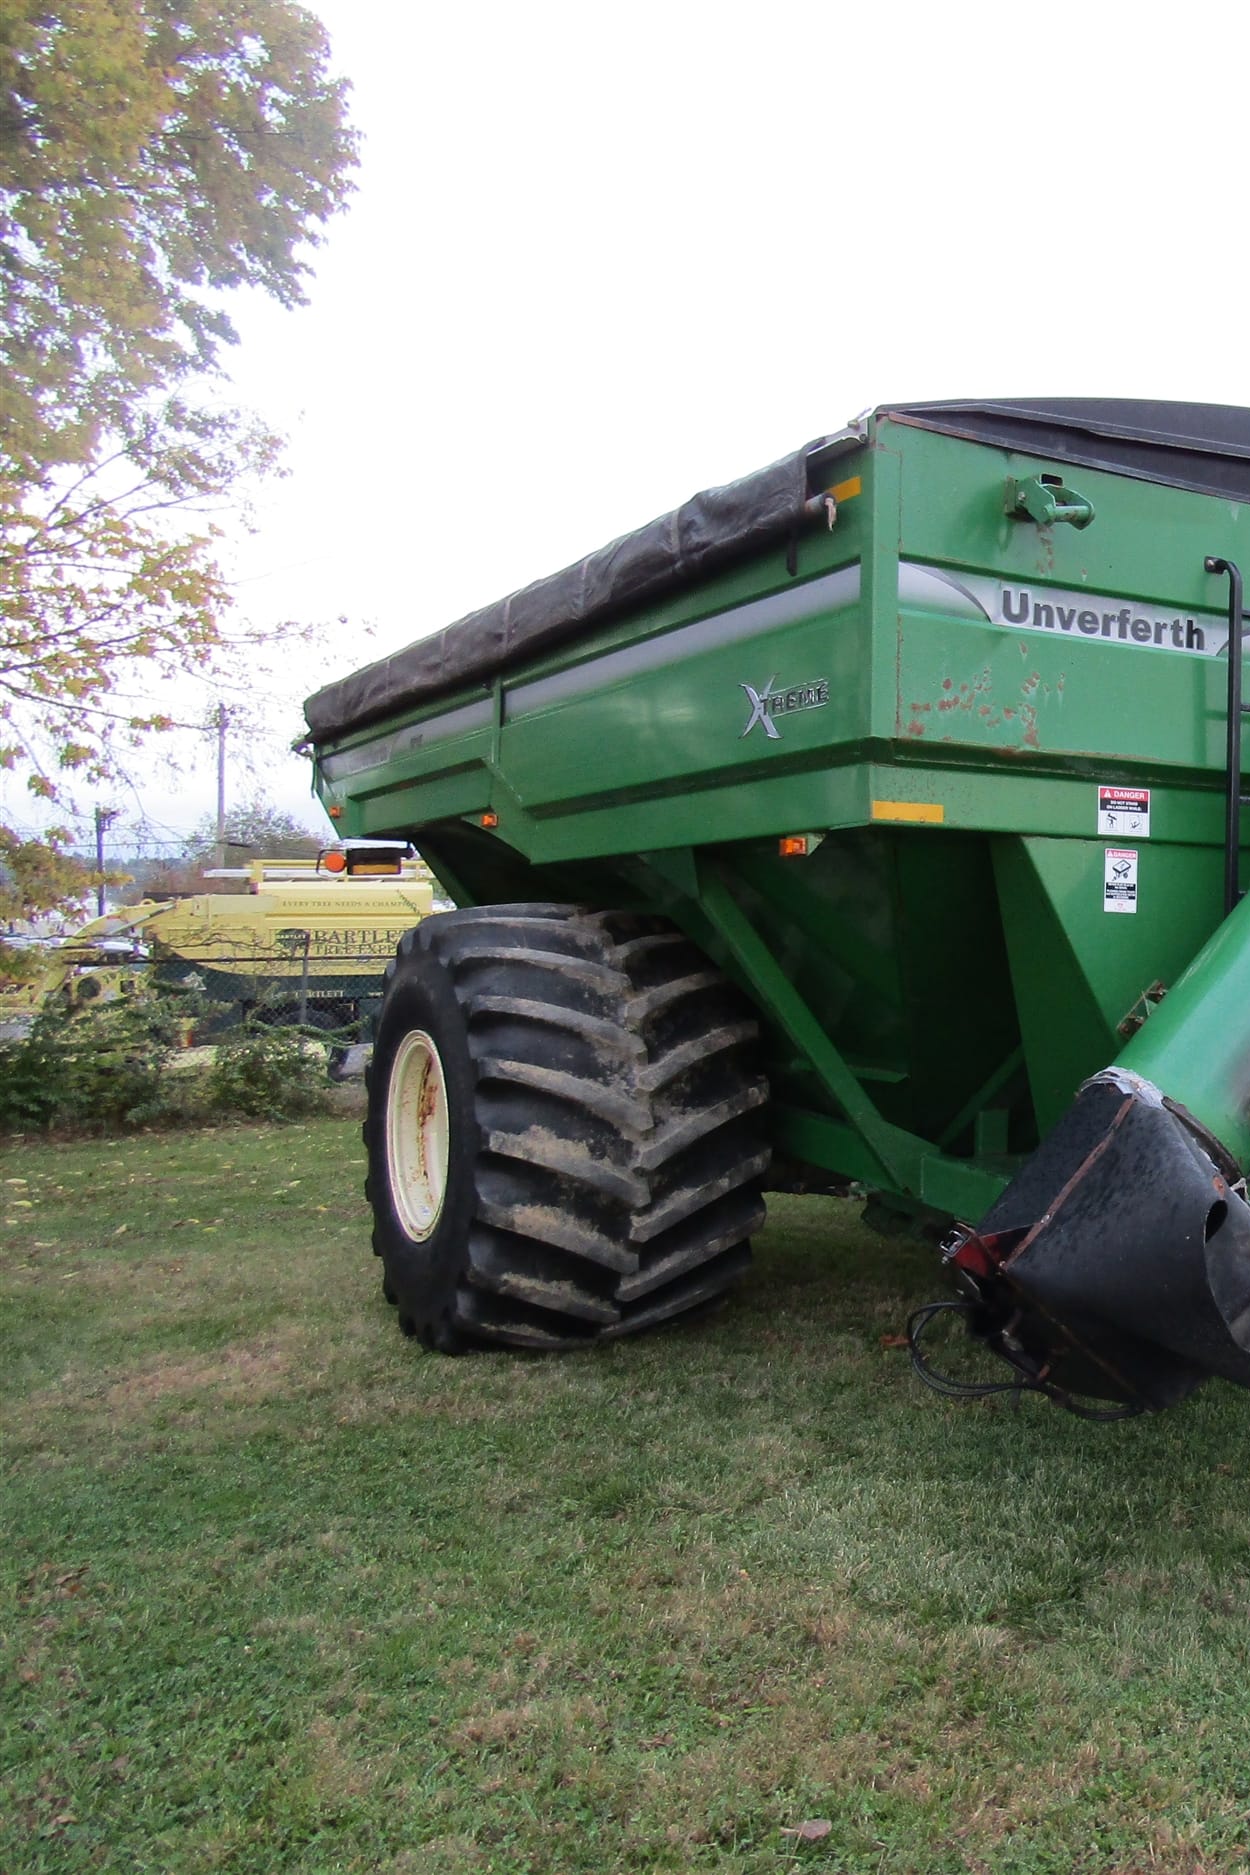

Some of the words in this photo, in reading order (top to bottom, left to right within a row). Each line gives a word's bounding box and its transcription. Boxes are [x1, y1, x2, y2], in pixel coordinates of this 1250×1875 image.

[1002, 590, 1205, 651] Unverferth
[738, 673, 830, 739] XTREME
[1113, 791, 1145, 800] DANGER
